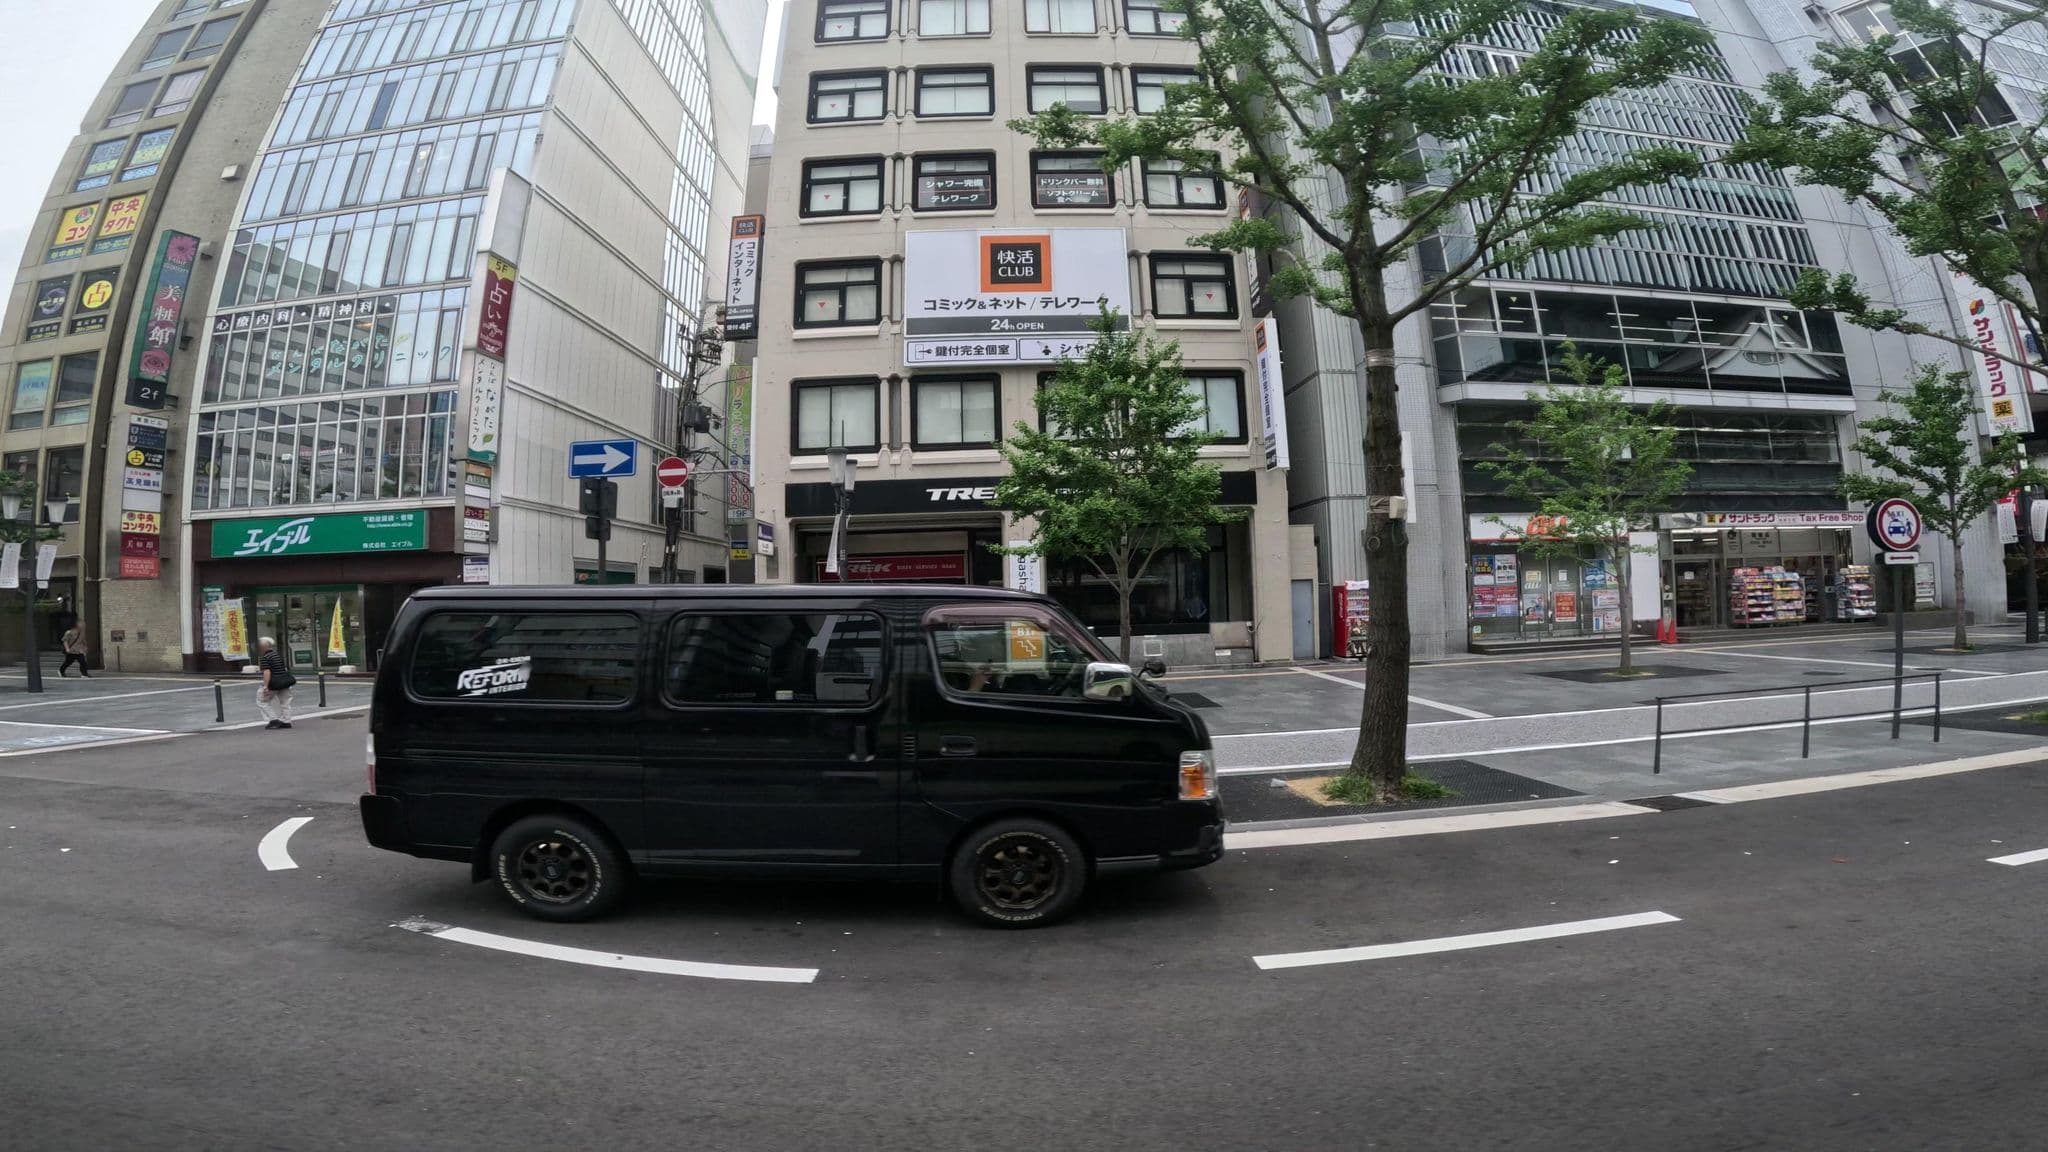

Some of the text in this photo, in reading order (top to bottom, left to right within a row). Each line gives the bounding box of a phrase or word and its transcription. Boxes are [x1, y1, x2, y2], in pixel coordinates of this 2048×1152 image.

[925, 178, 984, 189] シャワー完備
[1040, 178, 1104, 186] ドリンクバー無料
[930, 194, 978, 203] テレワーク
[111, 198, 140, 216] 中央
[744, 241, 756, 277] コミック
[997, 250, 1034, 264] 快活
[495, 261, 508, 273] 5F
[731, 241, 745, 304] インターネット
[997, 265, 1034, 277] CLUB
[487, 282, 508, 320] 占い
[923, 296, 1026, 311] コミック&ネット
[1016, 321, 1044, 330] OPEN
[935, 345, 1010, 357] 鍵付完全個室
[267, 346, 453, 377] メンタルクリニック
[472, 358, 485, 445] メンタルクリニック
[926, 487, 999, 501] TRE
[137, 513, 154, 523] 中央
[1800, 513, 1817, 522] Tax
[1819, 513, 1840, 522] Free
[1841, 513, 1864, 523] Shop
[122, 522, 158, 533] コンタクト
[234, 517, 315, 555] エイブル
